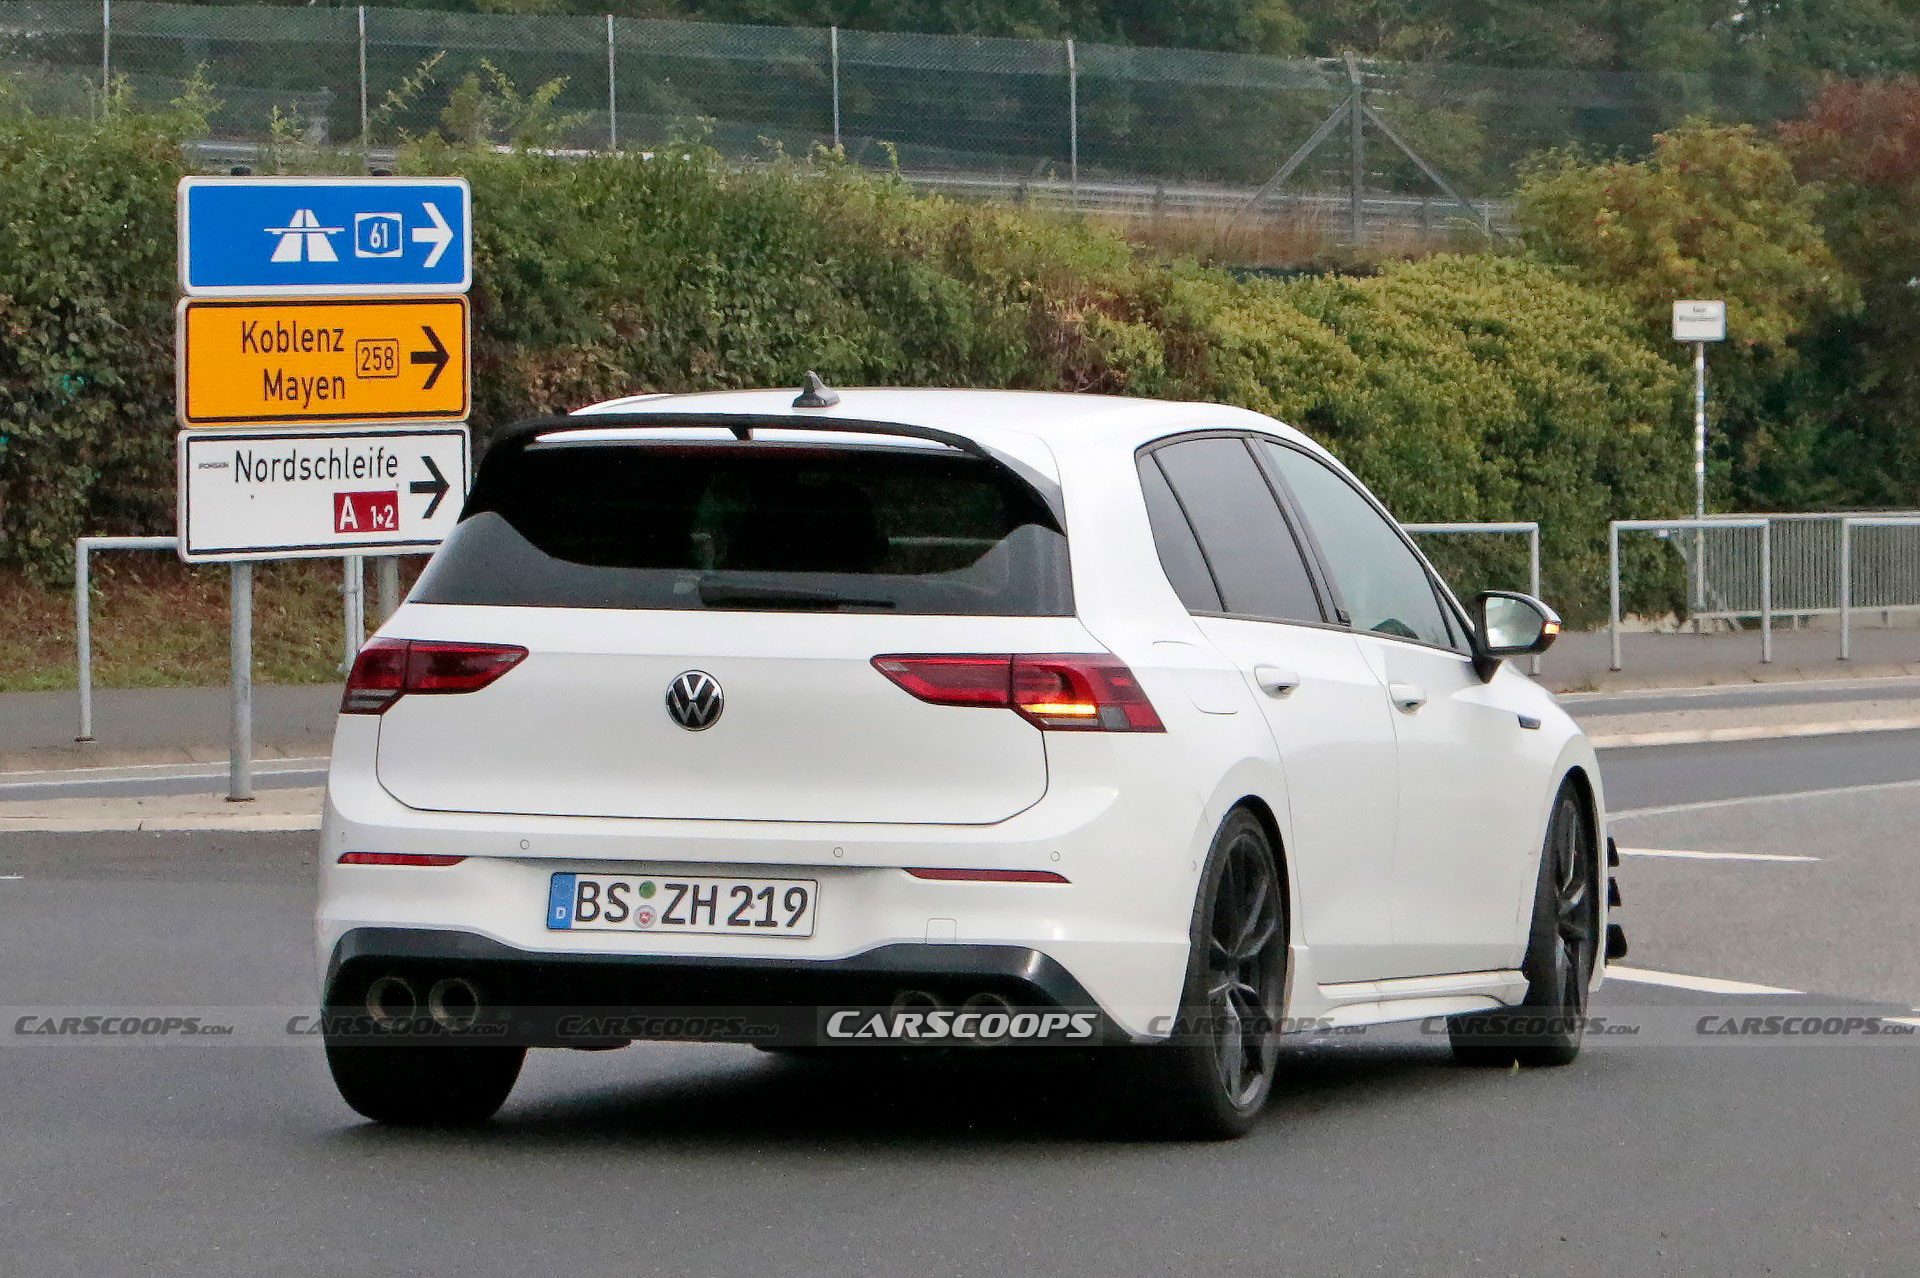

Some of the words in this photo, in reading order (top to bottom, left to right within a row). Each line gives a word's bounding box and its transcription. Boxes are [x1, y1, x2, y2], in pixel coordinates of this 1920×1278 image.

[369, 222, 389, 249] 61
[241, 320, 345, 354] Koblenz
[361, 346, 395, 371] 258
[263, 368, 346, 410] Mayen
[235, 446, 398, 484] Nordschleife
[339, 496, 359, 530] A
[555, 906, 567, 920] D
[574, 880, 632, 923] BS
[661, 883, 719, 926] ZH
[727, 885, 809, 928] 219
